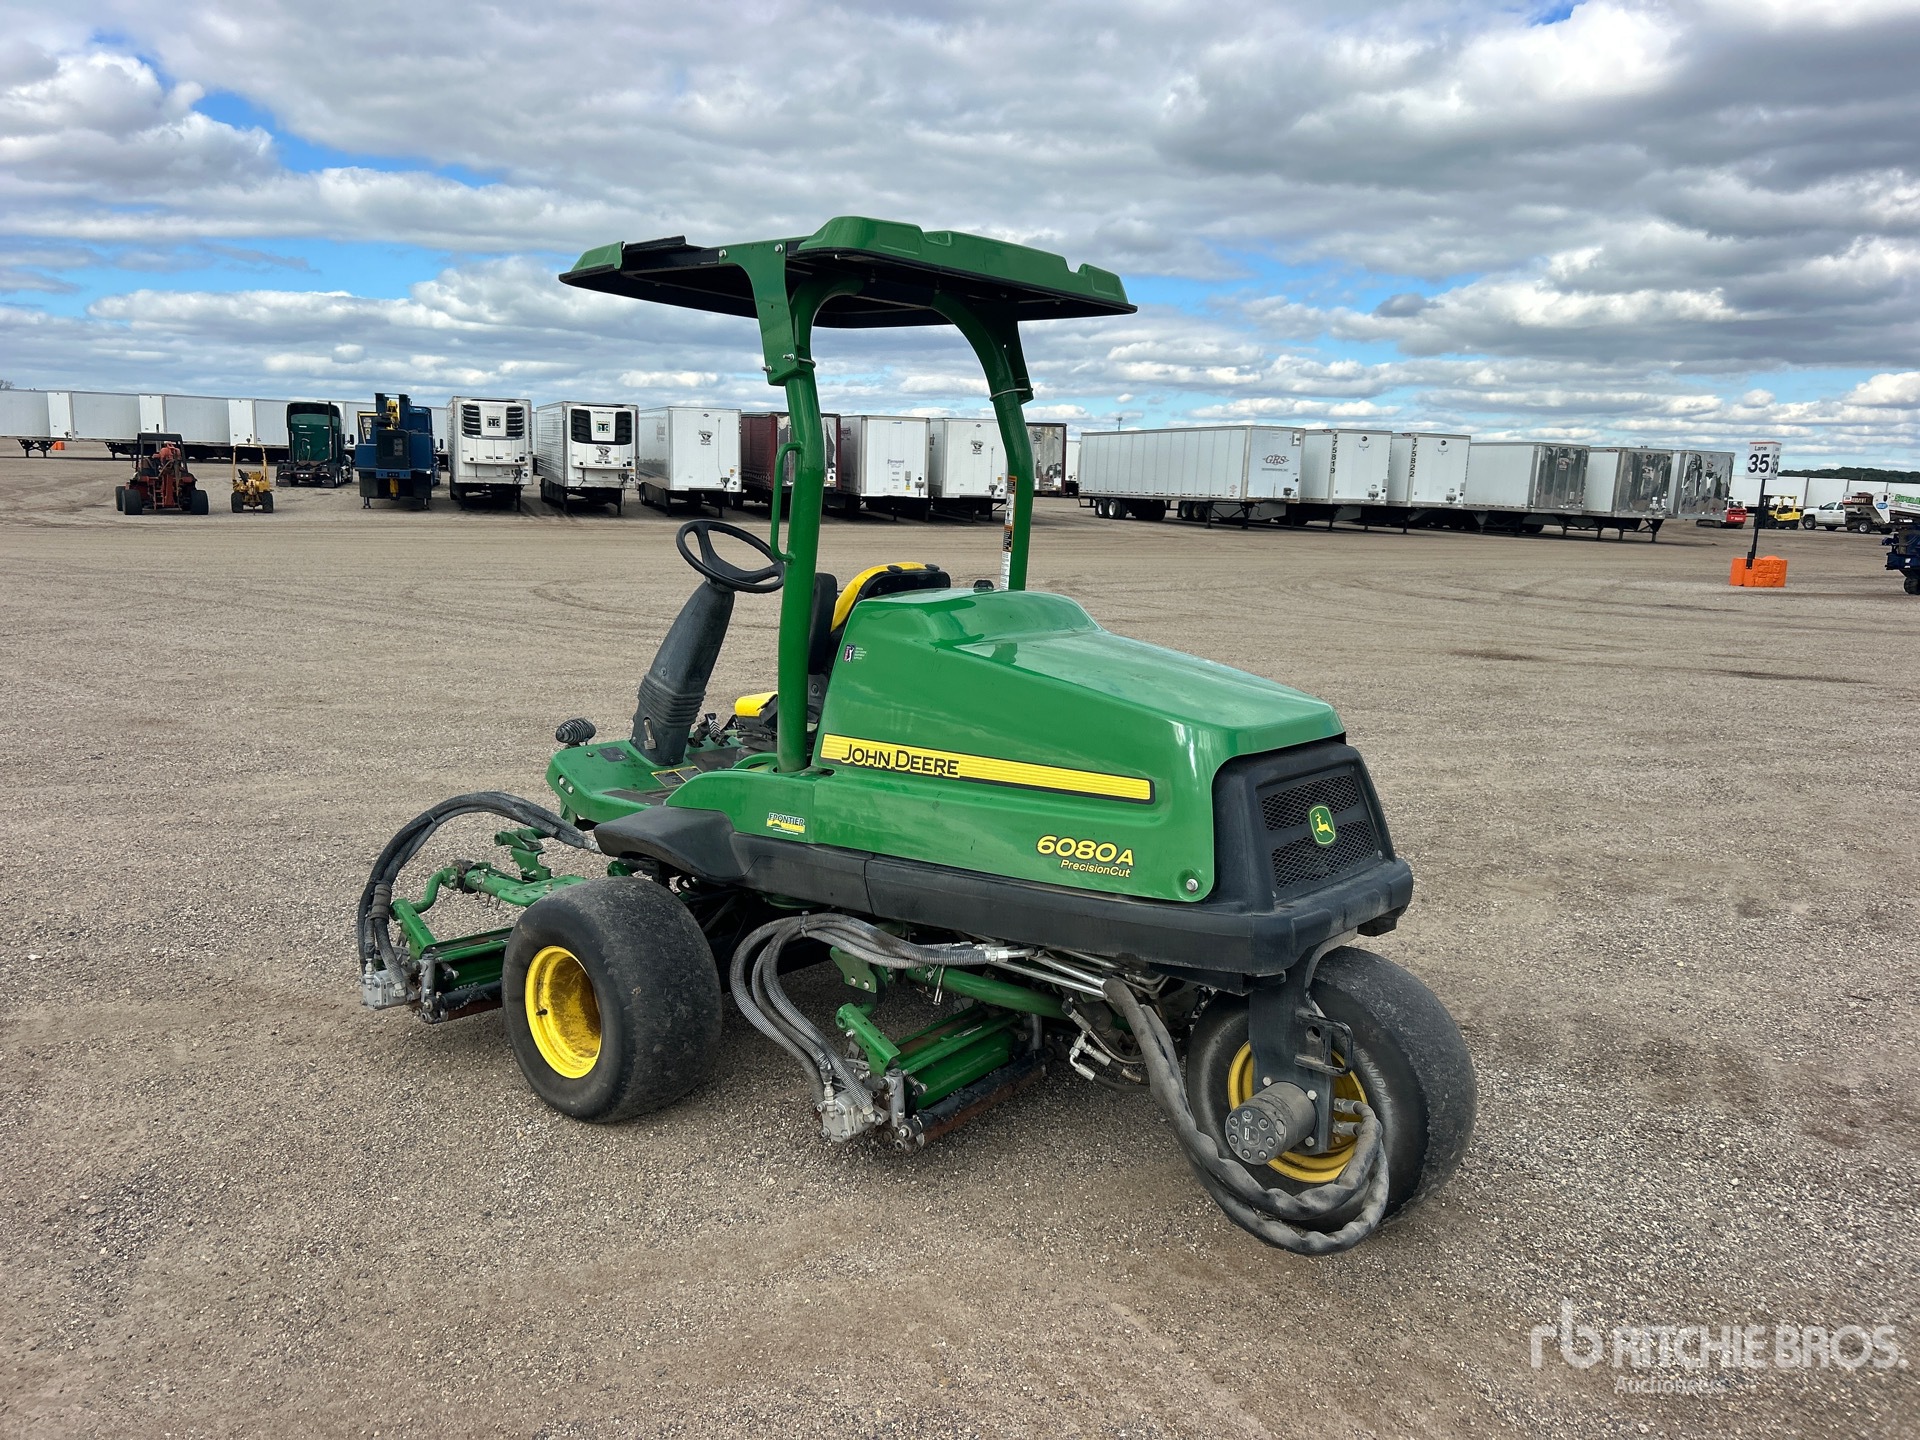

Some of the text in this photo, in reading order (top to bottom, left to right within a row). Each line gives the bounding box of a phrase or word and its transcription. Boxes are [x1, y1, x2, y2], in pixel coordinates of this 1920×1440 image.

[1330, 433, 1338, 474] 175819
[1409, 437, 1417, 478] 175822
[1747, 453, 1770, 473] 35
[841, 743, 960, 776] JOHN DEERE
[768, 812, 805, 827] FRONTIER
[1036, 834, 1135, 867] 6080A
[1060, 858, 1131, 878] PrecisionCut
